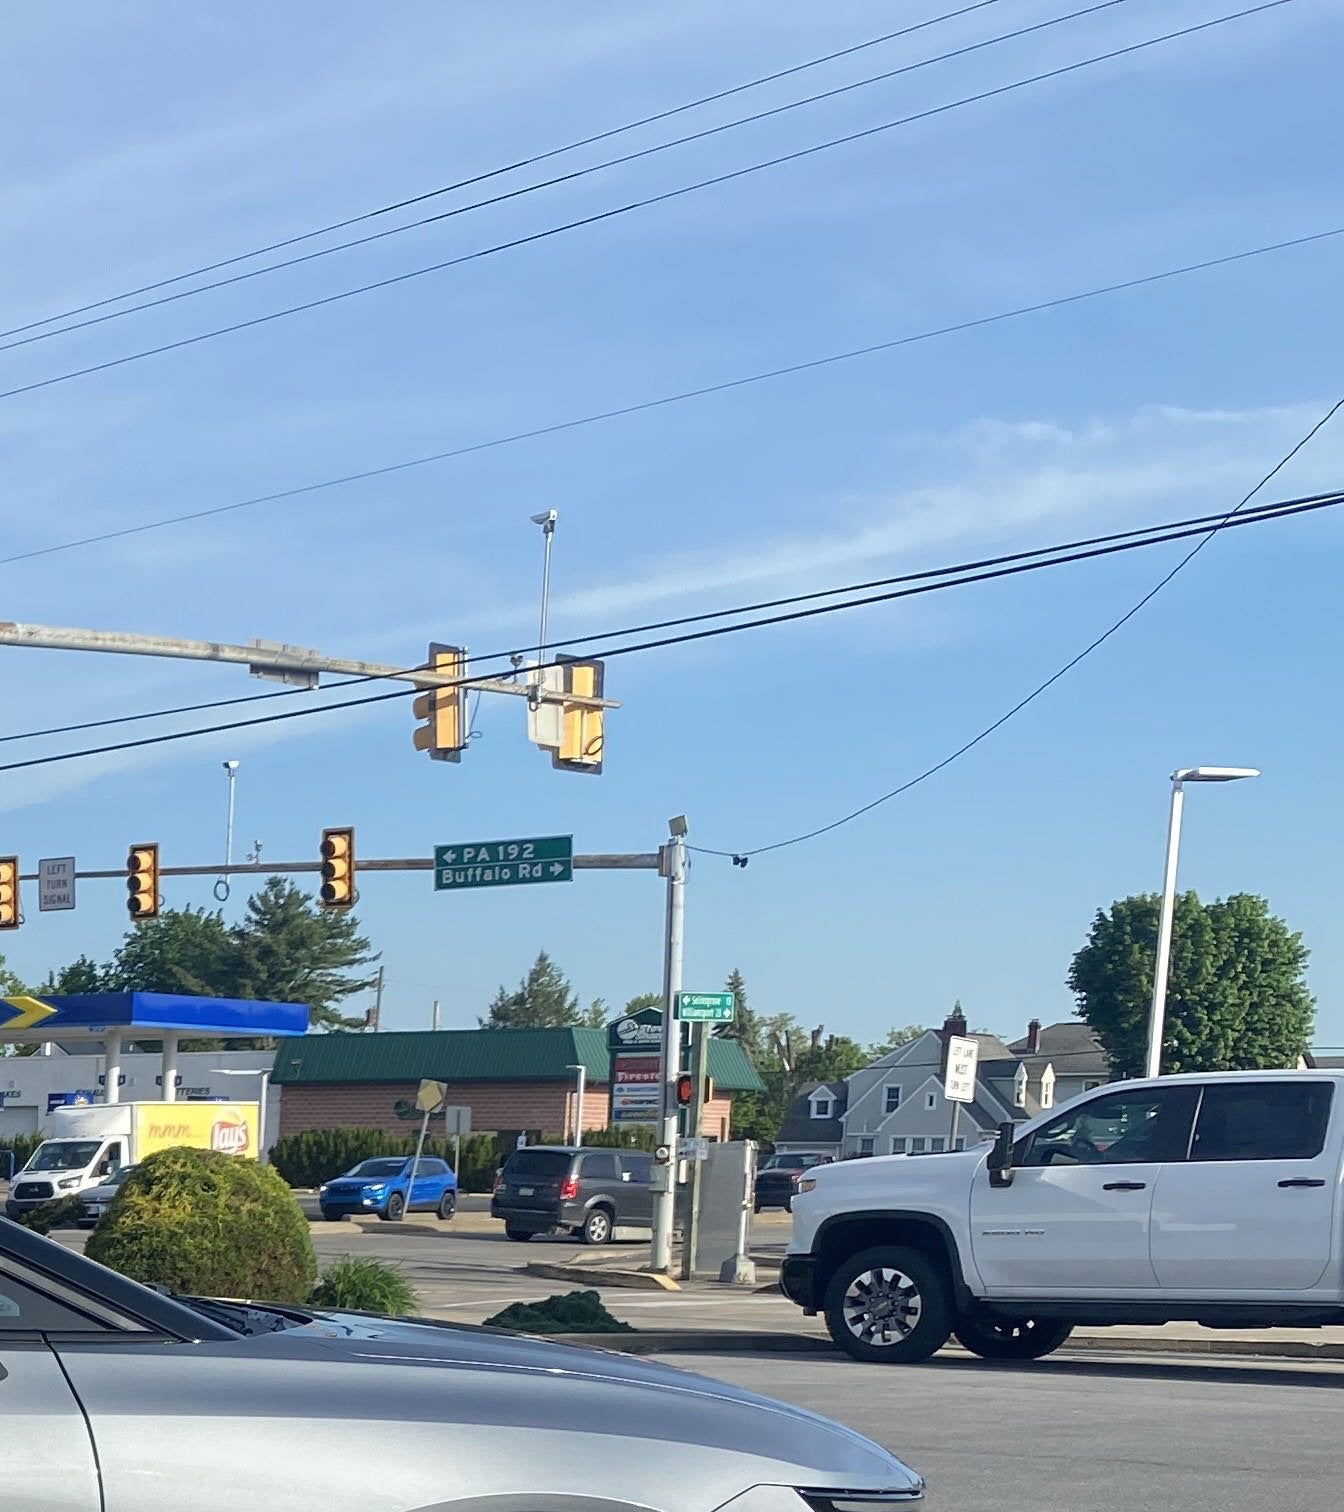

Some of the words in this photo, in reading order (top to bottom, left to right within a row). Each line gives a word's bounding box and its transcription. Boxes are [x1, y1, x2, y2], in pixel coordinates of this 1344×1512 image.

[463, 847, 491, 863] PA
[498, 843, 535, 861] 192
[442, 866, 511, 884] Buffalo
[518, 863, 543, 879] Rd
[176, 1087, 211, 1097] TTERIES
